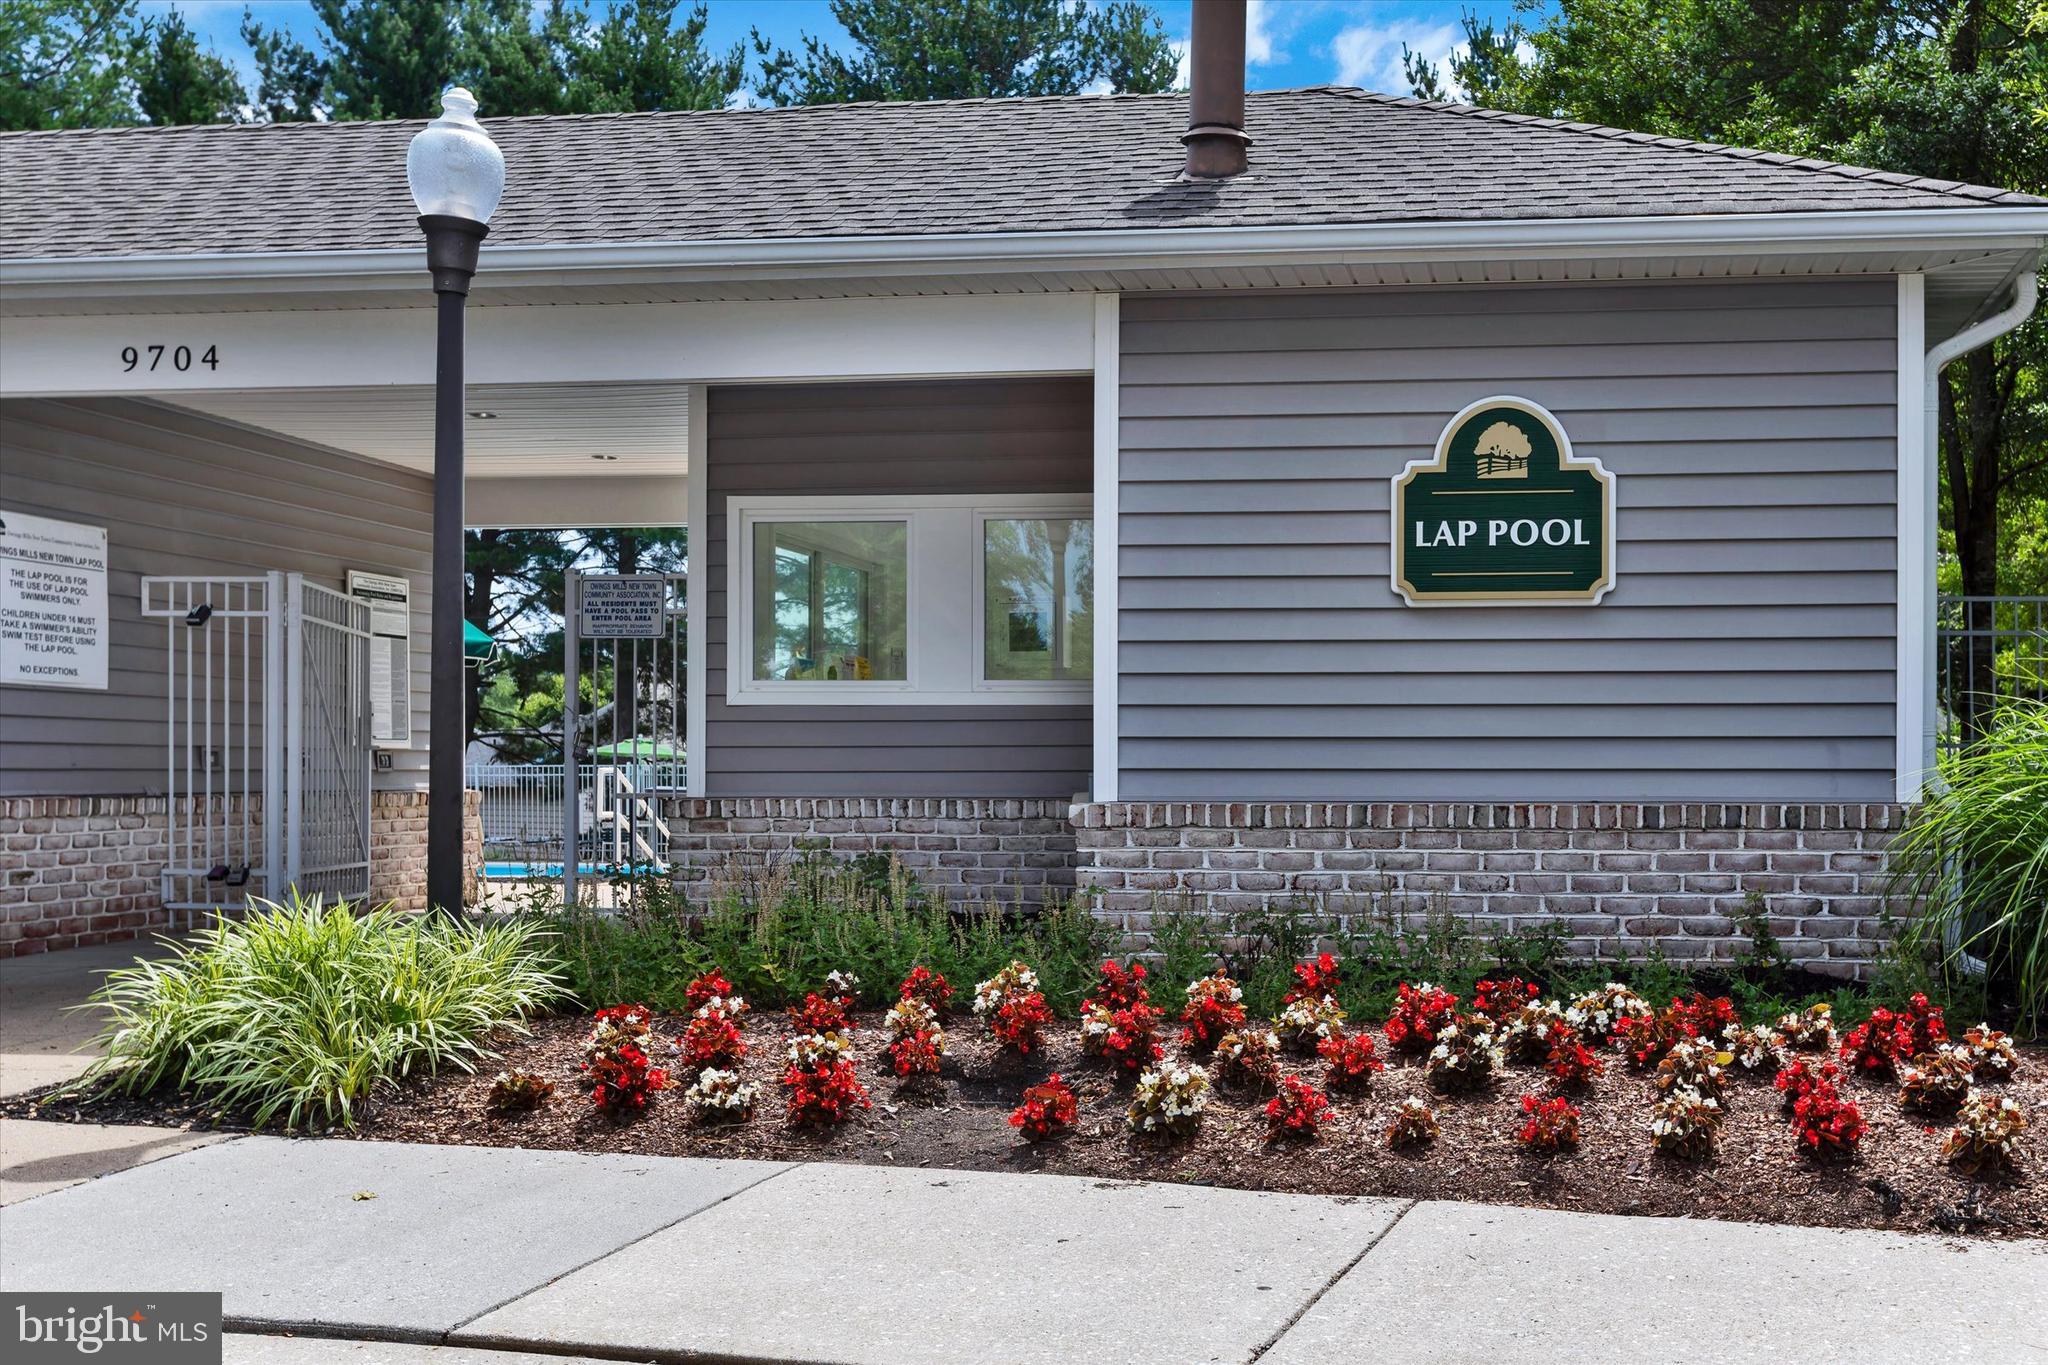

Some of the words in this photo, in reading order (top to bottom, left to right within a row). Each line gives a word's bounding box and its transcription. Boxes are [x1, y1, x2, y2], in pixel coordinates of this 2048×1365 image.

[121, 344, 219, 373] 9704
[1416, 520, 1478, 547] LAP
[1488, 518, 1590, 547] POOL
[20, 548, 38, 560] MILLS
[39, 552, 54, 562] NEW
[56, 554, 74, 564] TOWN
[75, 556, 86, 566] LAP
[88, 559, 104, 568] POOL
[11, 568, 25, 578] THE
[28, 570, 42, 580] LAP
[44, 572, 63, 583] POOL
[65, 576, 72, 584] IS
[74, 577, 88, 586] FOR
[10, 579, 24, 589] THE
[26, 581, 40, 590] USE
[43, 583, 53, 592] OF
[54, 585, 68, 594] LAP
[70, 587, 88, 596] POOL
[20, 592, 60, 604] SWIMMERS
[2, 608, 40, 620] CHILDREN
[42, 612, 66, 622] UNDER
[78, 616, 96, 625] MUST
[0, 620, 20, 629] TAKE
[22, 621, 28, 629] A
[30, 622, 70, 634] SWIMMER'S
[72, 626, 97, 636] ABILITY
[2, 630, 22, 640] SWIM
[25, 632, 42, 641] TEST
[45, 634, 74, 644] BEFORE
[76, 637, 96, 646] USING
[24, 642, 40, 652] THE
[41, 644, 55, 653] LAP
[20, 664, 31, 674] NO
